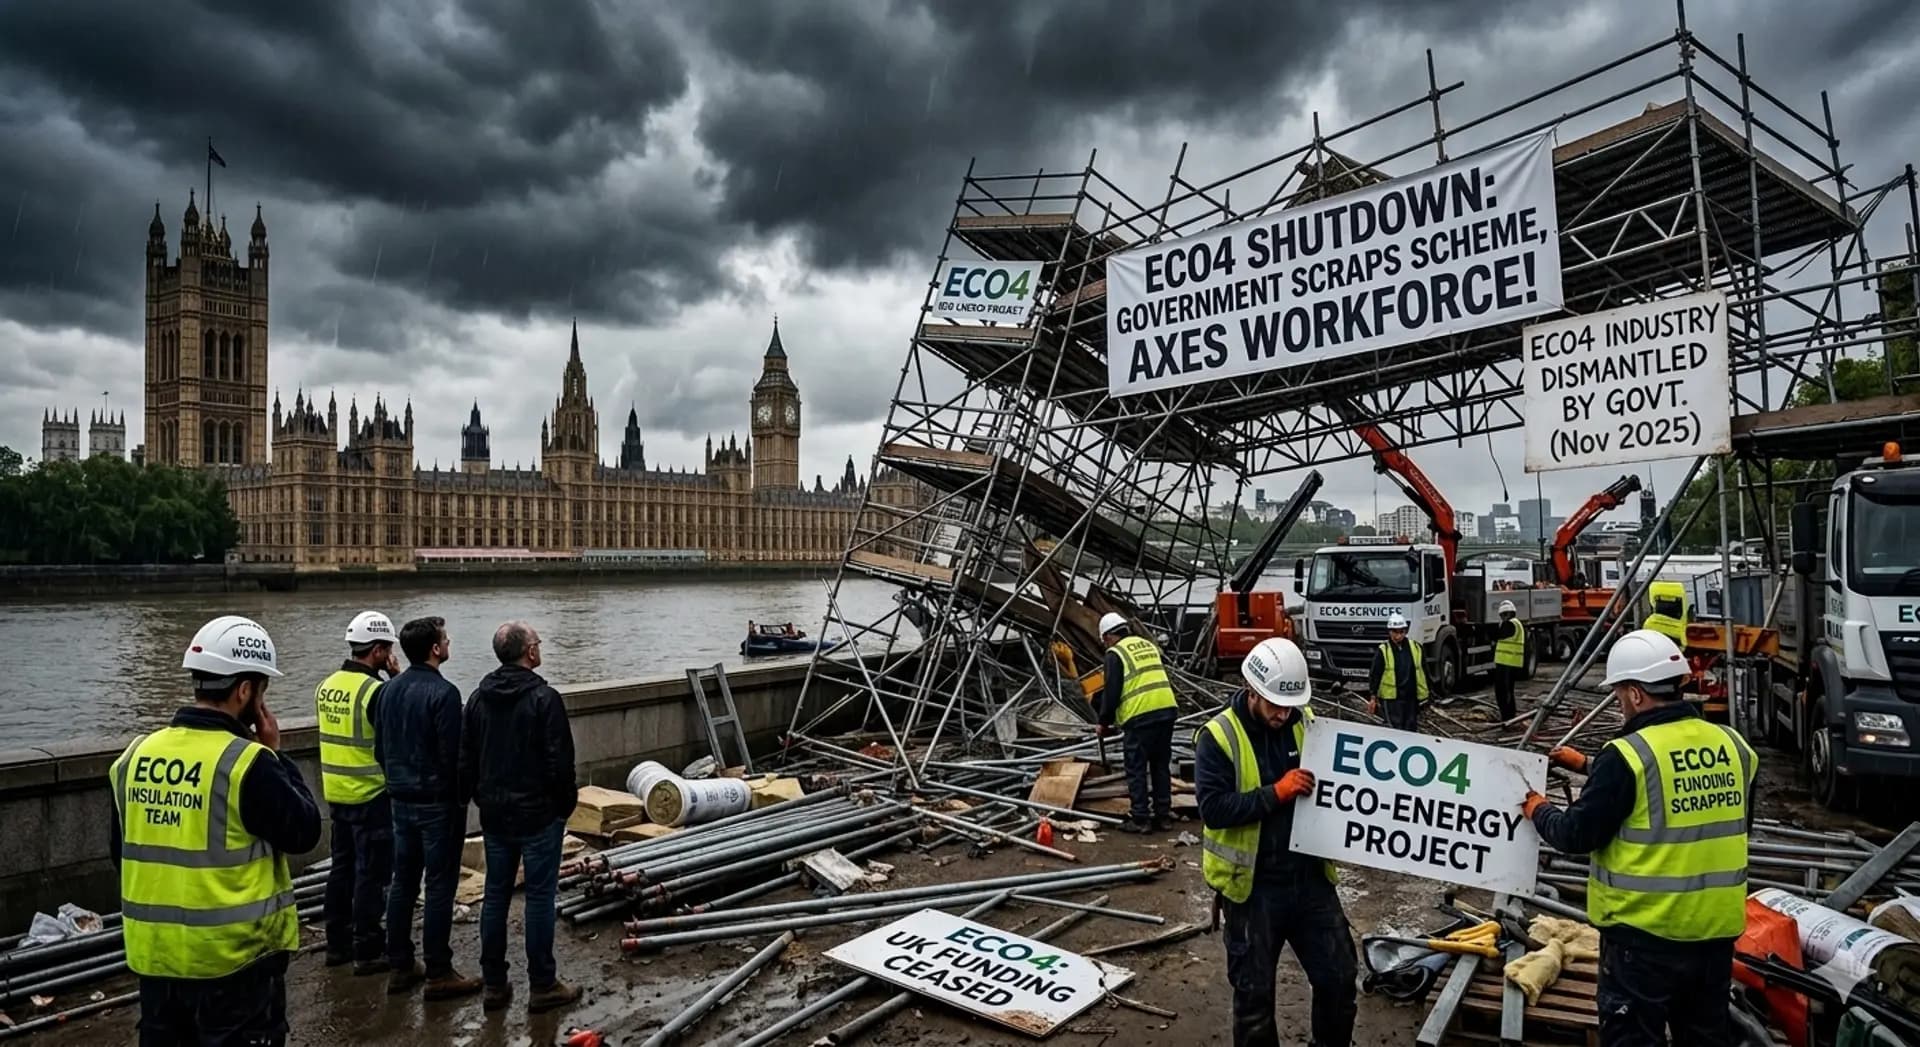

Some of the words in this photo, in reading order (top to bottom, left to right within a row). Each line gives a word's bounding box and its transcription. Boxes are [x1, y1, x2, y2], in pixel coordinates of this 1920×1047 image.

[1146, 236, 1236, 294] ECO4
[1247, 167, 1497, 269] SHUTDOWN:
[943, 267, 1031, 301] ECO4
[1117, 272, 1283, 334] GOVERNMENT
[1291, 244, 1401, 298] SCRAPS
[1410, 207, 1548, 269] SCHEME,
[1128, 323, 1229, 384] AXES
[1240, 251, 1538, 361] WORKFORCE!
[1531, 325, 1595, 361] ECO4
[1605, 302, 1720, 347] INDUSTRY
[1541, 342, 1708, 392] DISMANTLED
[1562, 392, 1595, 422] BY
[1606, 380, 1688, 416] GOVT.
[1550, 429, 1610, 463] (Nov
[1618, 411, 1701, 450] 2025)
[1319, 606, 1347, 617] ECO4
[134, 756, 203, 788] ECO4
[1332, 733, 1471, 795] ECO4
[1669, 744, 1731, 773] ECO4
[128, 787, 203, 810] INSULATION
[145, 808, 181, 828] TEAM
[1315, 779, 1523, 841] ECO-ENERGY
[1671, 790, 1742, 814] SCRAPPED
[1344, 820, 1491, 874] PROJECT
[885, 931, 939, 954] UK
[932, 947, 1076, 1002] FUNDING
[944, 926, 1069, 975] ECO4:
[883, 955, 1014, 1006] CEASED
